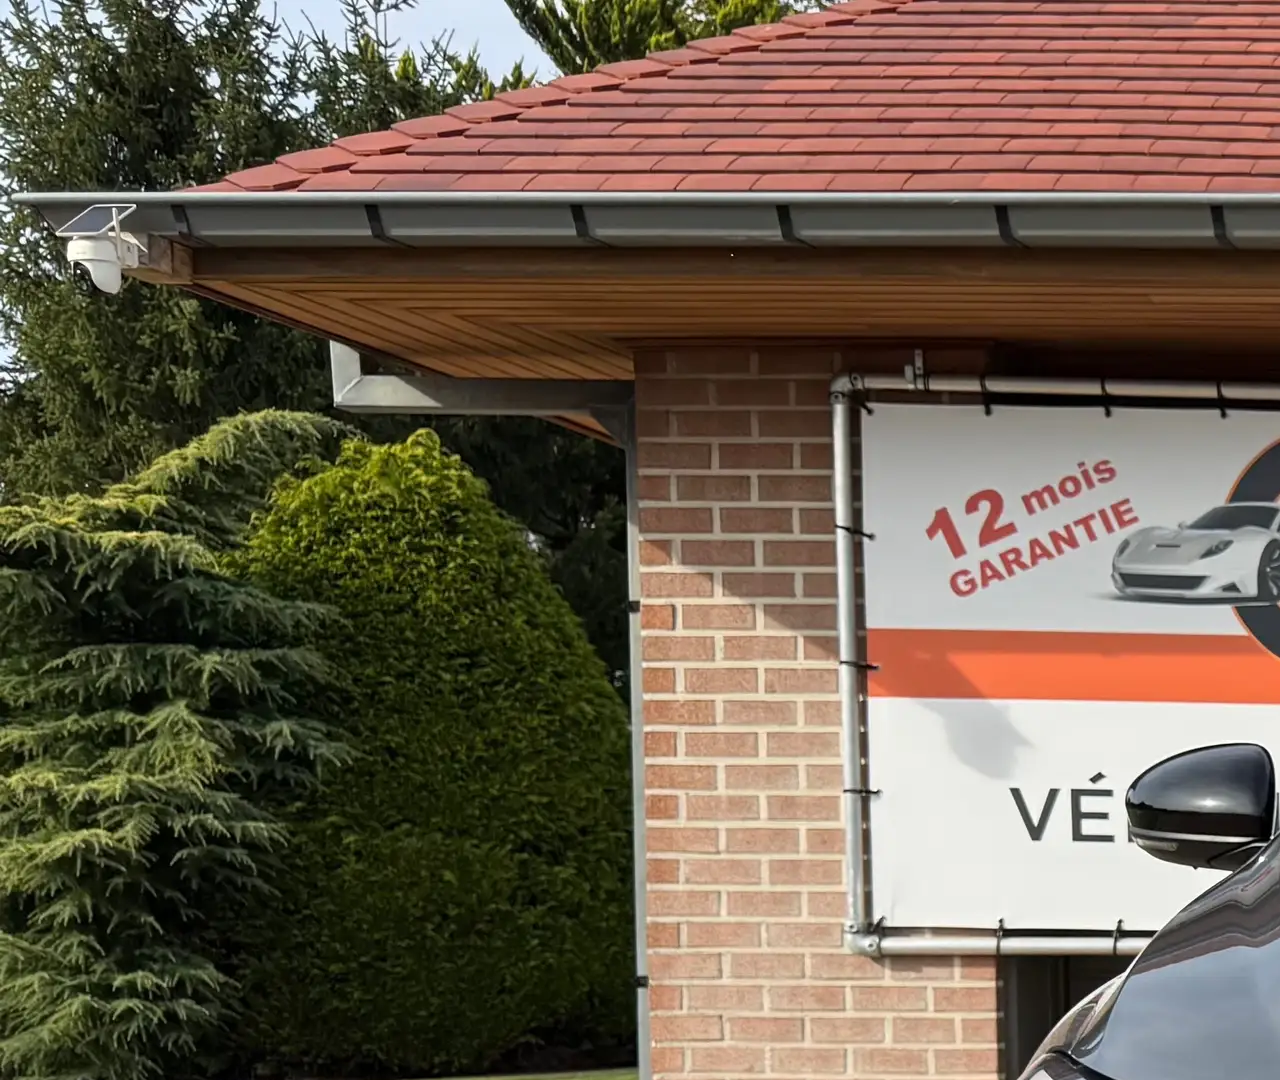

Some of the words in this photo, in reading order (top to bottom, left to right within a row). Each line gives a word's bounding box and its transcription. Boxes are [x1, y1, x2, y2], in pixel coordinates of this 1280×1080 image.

[925, 488, 1018, 560] 12
[1021, 459, 1117, 516] mois
[949, 497, 1139, 598] GARANTIE
